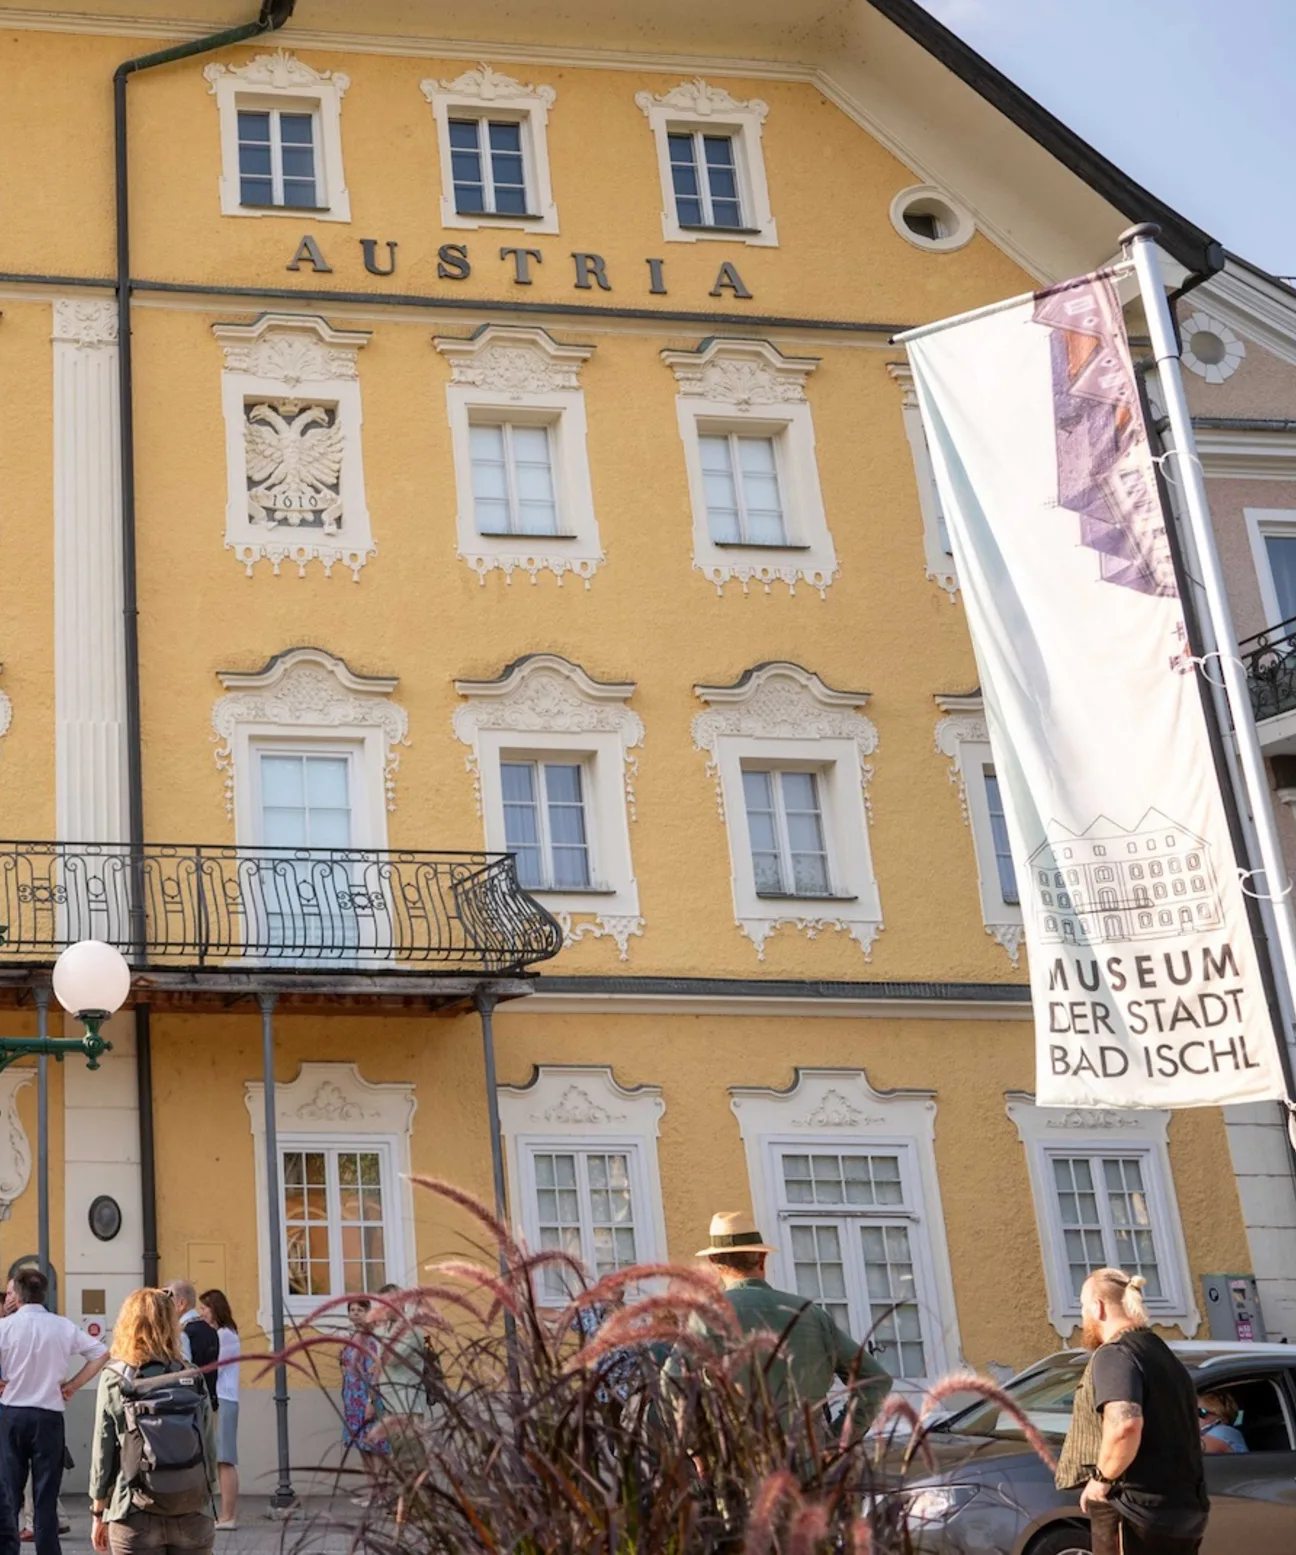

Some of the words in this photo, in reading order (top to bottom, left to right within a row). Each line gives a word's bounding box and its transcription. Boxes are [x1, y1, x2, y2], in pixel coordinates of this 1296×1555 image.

[286, 235, 753, 299] AUSTRIA
[1048, 943, 1240, 992] MUSEUM
[1049, 1001, 1116, 1034] DER
[1127, 988, 1244, 1034] STADT
[1049, 1044, 1129, 1078] BAD
[1143, 1035, 1260, 1078] ISCHL
